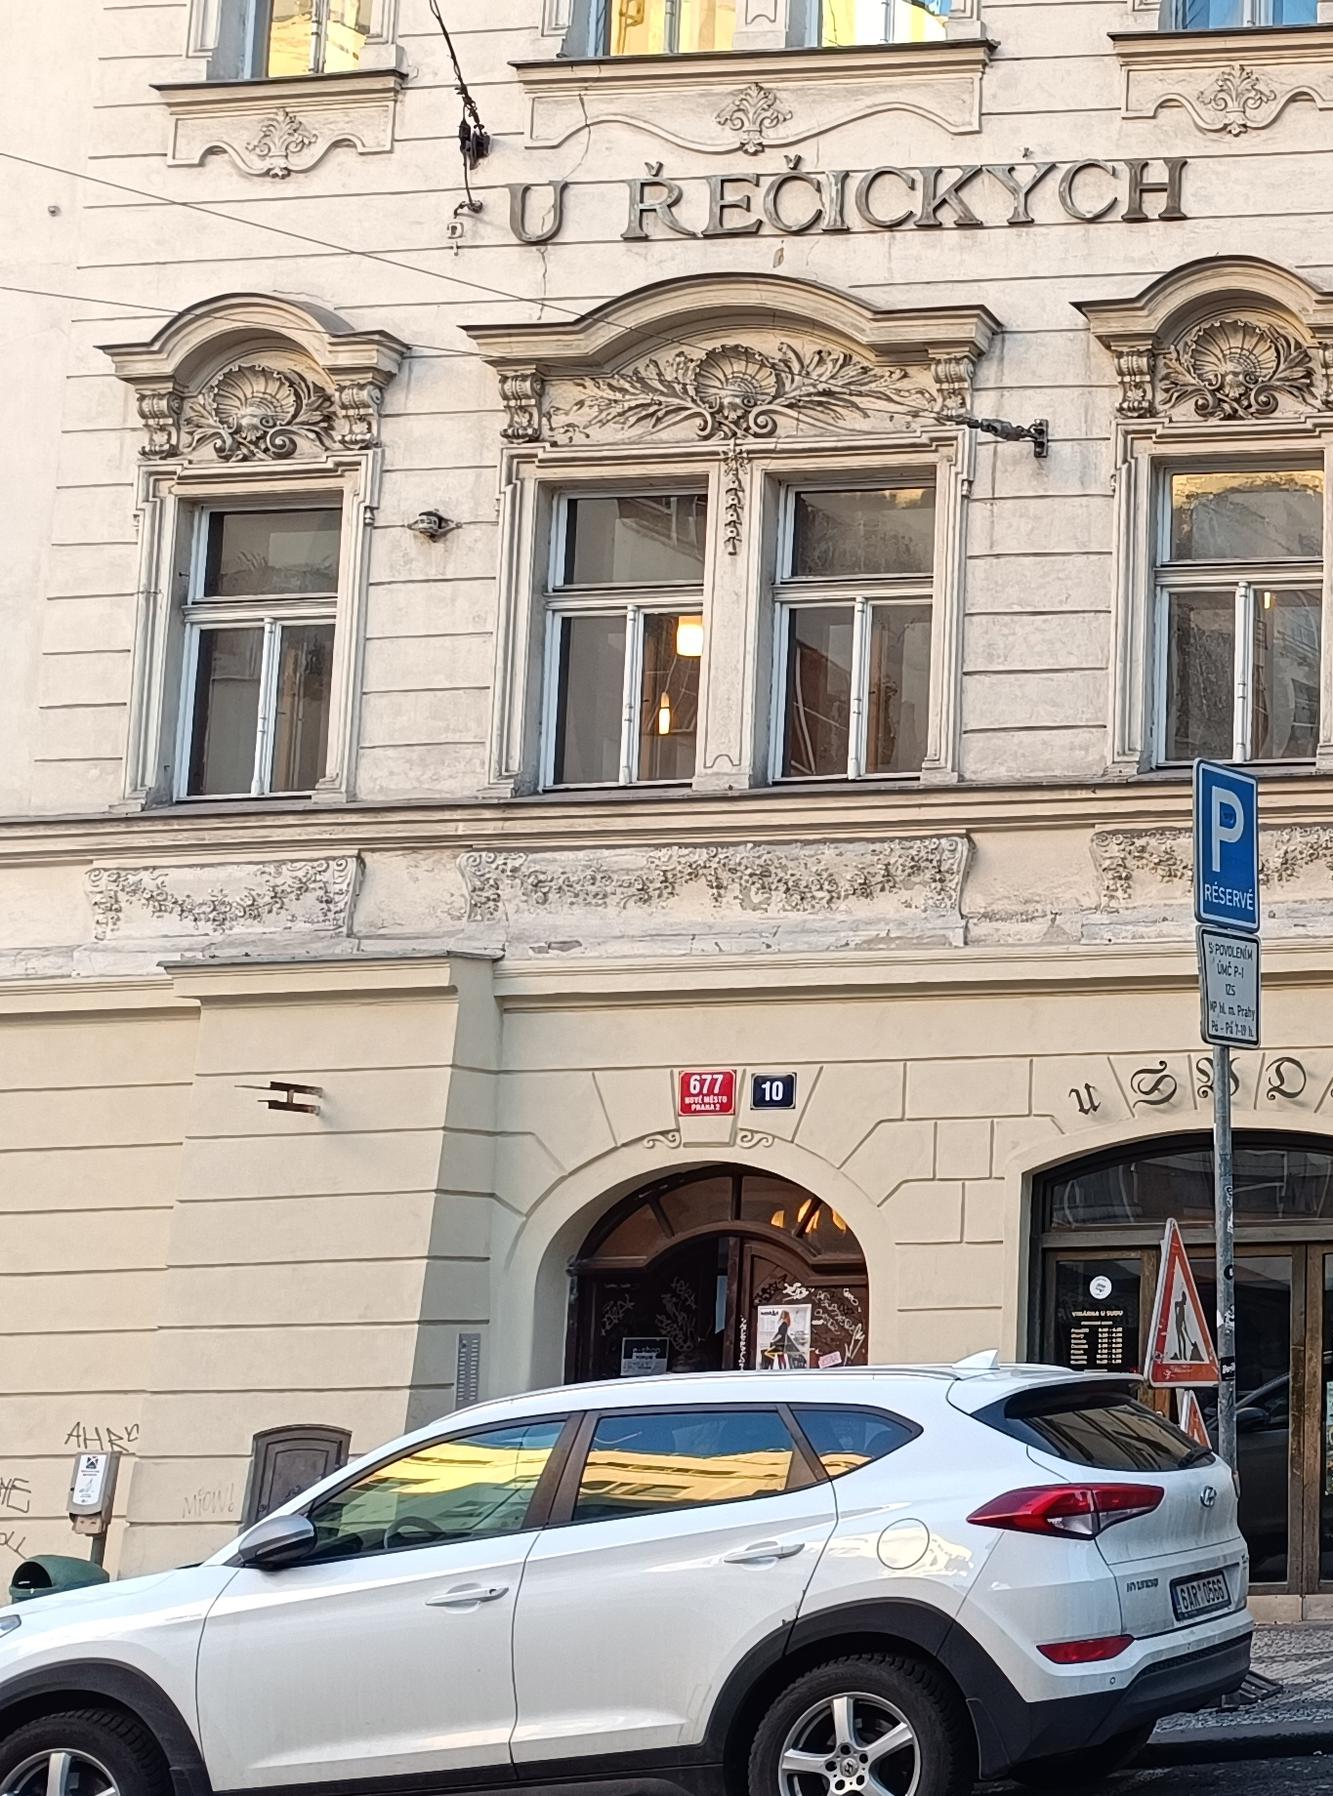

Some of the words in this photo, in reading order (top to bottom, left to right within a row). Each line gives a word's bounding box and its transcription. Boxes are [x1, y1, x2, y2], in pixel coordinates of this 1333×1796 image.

[507, 179, 568, 244] U
[621, 146, 1189, 240] ŘEČICKÝCH
[1212, 785, 1245, 873] P
[1204, 882, 1254, 911] RÉSERVÉ
[1215, 944, 1253, 960] POVOLENÍM
[689, 1074, 724, 1094] 677
[761, 1081, 784, 1101] 10
